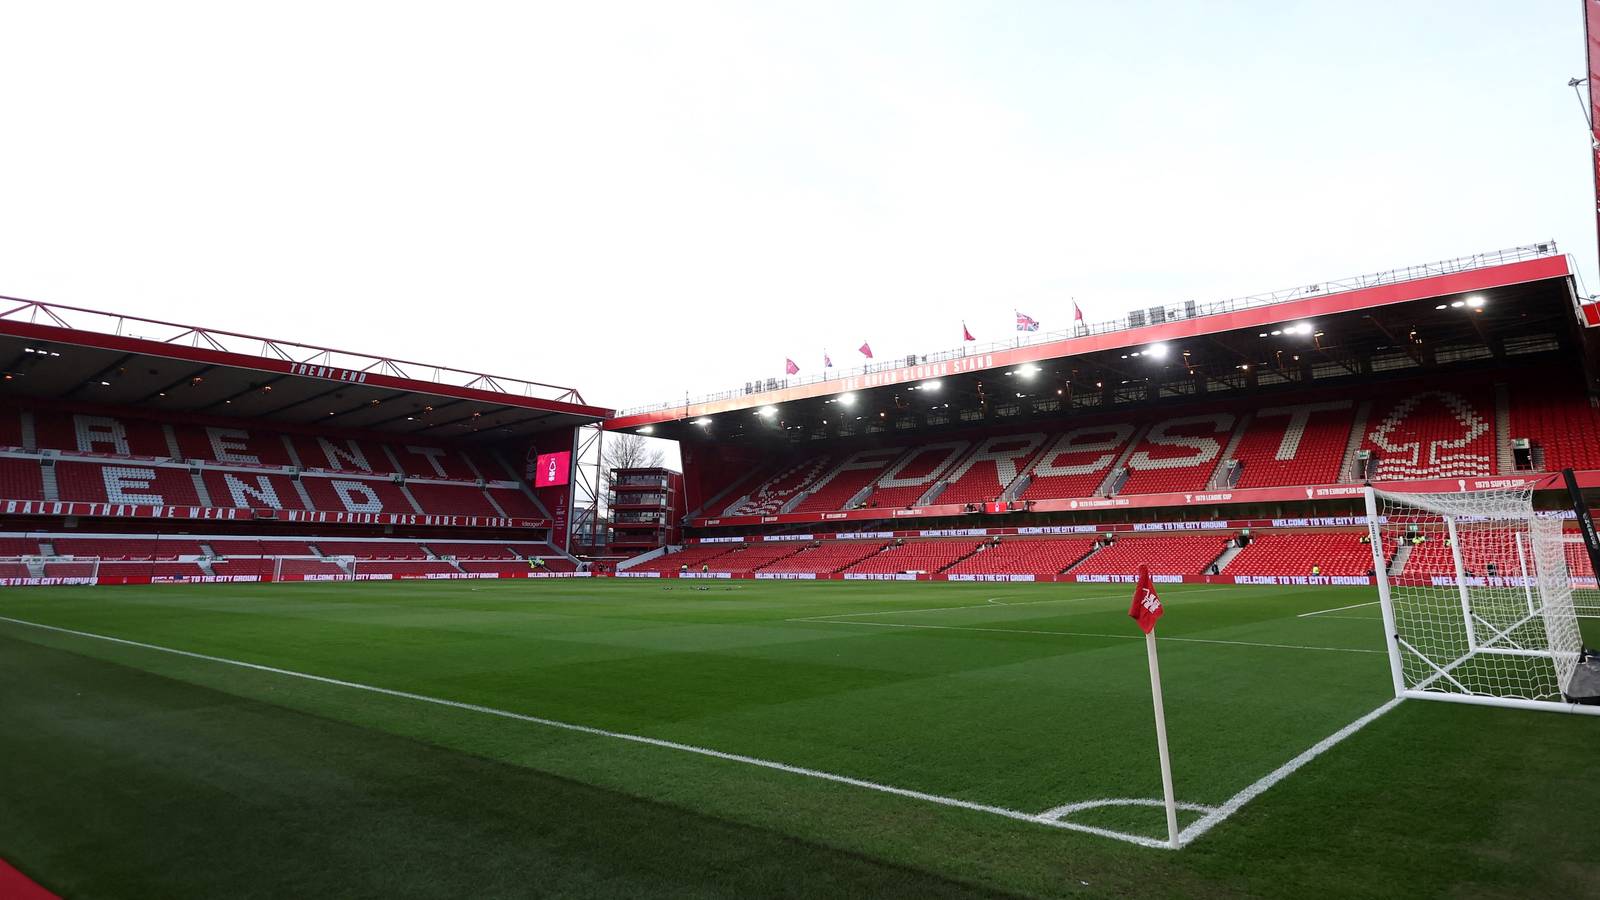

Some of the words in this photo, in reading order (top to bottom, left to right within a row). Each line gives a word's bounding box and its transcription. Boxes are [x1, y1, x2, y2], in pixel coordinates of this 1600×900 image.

[290, 362, 335, 379] TRENT
[341, 370, 367, 383] END
[903, 362, 948, 380] CLOUGH
[953, 355, 993, 373] STAND
[1512, 479, 1525, 487] CUP
[102, 466, 384, 514] END
[1357, 486, 1366, 494] CU
[6, 500, 74, 516] BALDI
[90, 503, 138, 517] THAT
[152, 505, 176, 518] WE
[189, 506, 236, 520] WEAR
[288, 509, 326, 522] WITH
[337, 511, 380, 524] PRIDE
[390, 513, 417, 525] WAS
[425, 515, 457, 526] MADE
[465, 516, 477, 527] IN
[486, 518, 513, 528] 1865
[1133, 522, 1164, 531] WELCOME
[1165, 522, 1173, 530] TO
[1173, 521, 1186, 530] THE
[1186, 521, 1201, 529] CITY
[1201, 520, 1227, 529] GROUND
[1272, 518, 1309, 527] WELCOME
[1309, 517, 1320, 526] TO
[1320, 516, 1336, 526] THE
[1336, 515, 1354, 525] CITY
[23, 577, 40, 585] THE
[41, 577, 63, 585] CITY
[996, 574, 1010, 582] CITY
[1010, 574, 1035, 582] GROUND
[1076, 575, 1110, 583] WELCOME
[1111, 575, 1120, 583] TO
[1120, 575, 1134, 583] THE
[1152, 575, 1183, 583] GROUND
[1234, 575, 1278, 585] WELCOME
[1278, 575, 1290, 585] TO
[1290, 576, 1308, 585] THE
[1309, 575, 1330, 585] CITY
[1331, 576, 1370, 585] GROUND
